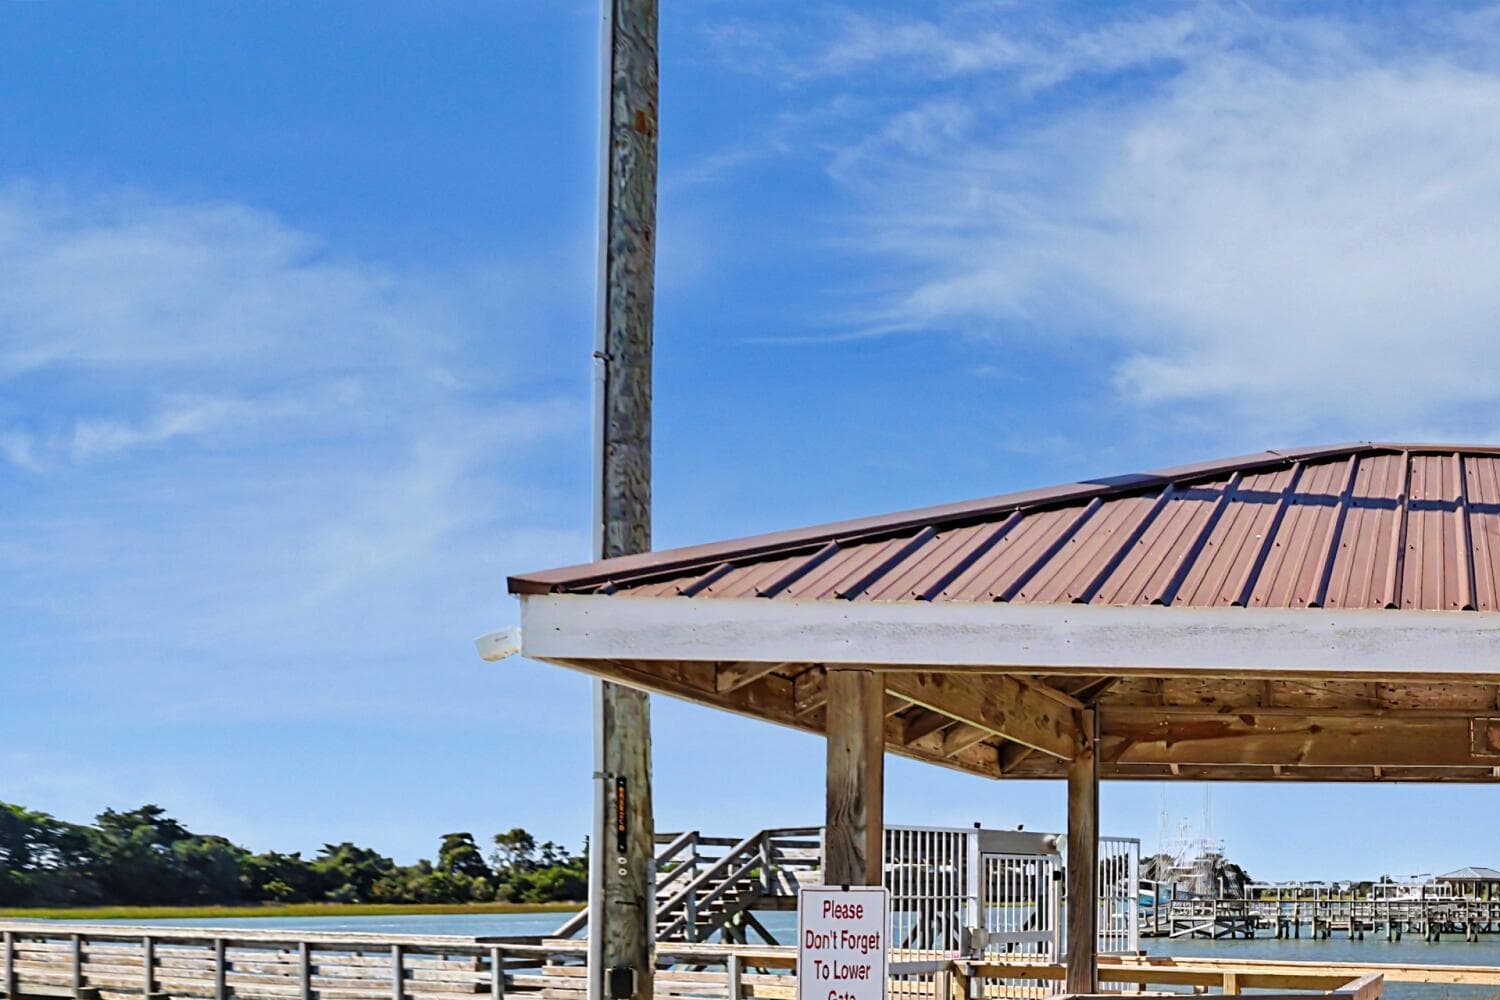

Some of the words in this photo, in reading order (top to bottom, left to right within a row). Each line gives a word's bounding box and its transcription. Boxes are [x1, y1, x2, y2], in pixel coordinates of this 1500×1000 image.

[823, 900, 863, 920] Please
[805, 930, 838, 950] Don't
[841, 930, 880, 954] Forget
[814, 960, 830, 980] To
[834, 960, 871, 980] Lower
